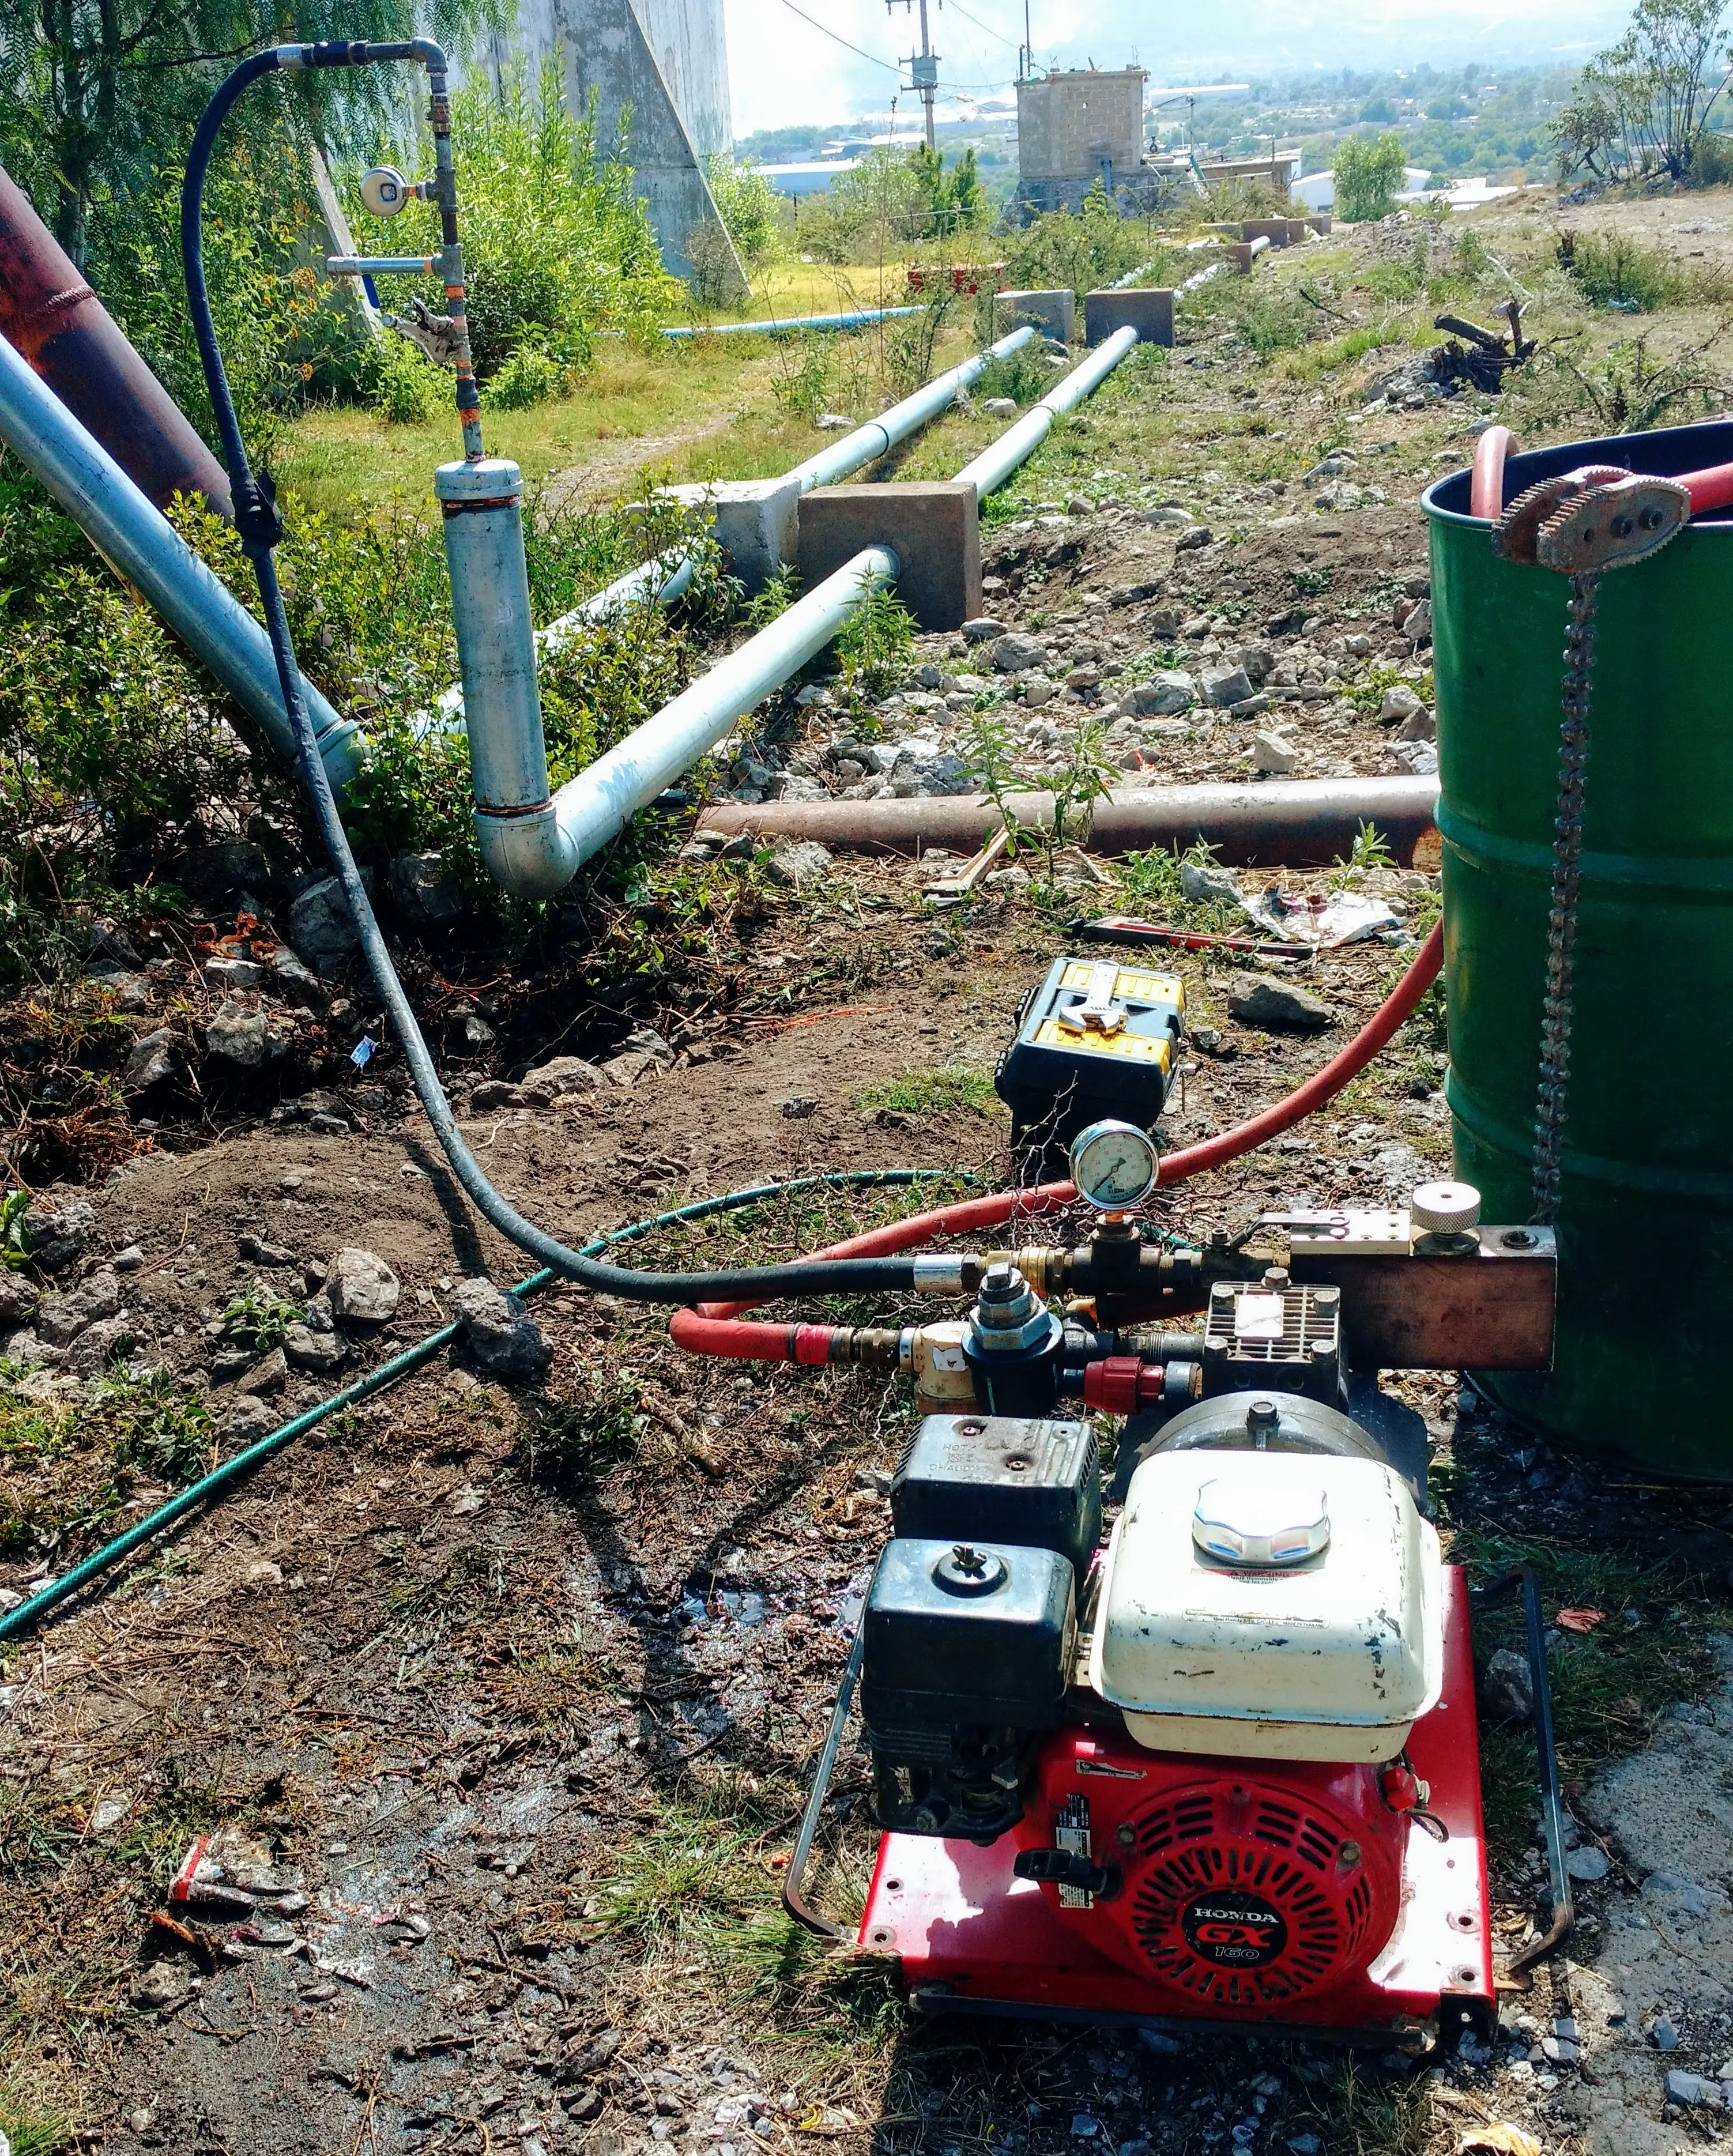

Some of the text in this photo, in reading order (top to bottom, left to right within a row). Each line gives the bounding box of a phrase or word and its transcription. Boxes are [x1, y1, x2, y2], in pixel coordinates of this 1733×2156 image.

[942, 1443, 969, 1452] HOT
[929, 1463, 970, 1472] CHAUD
[1194, 1907, 1279, 1923] HONDA
[1196, 1923, 1275, 1947] GX
[1215, 1946, 1260, 1959] 160
